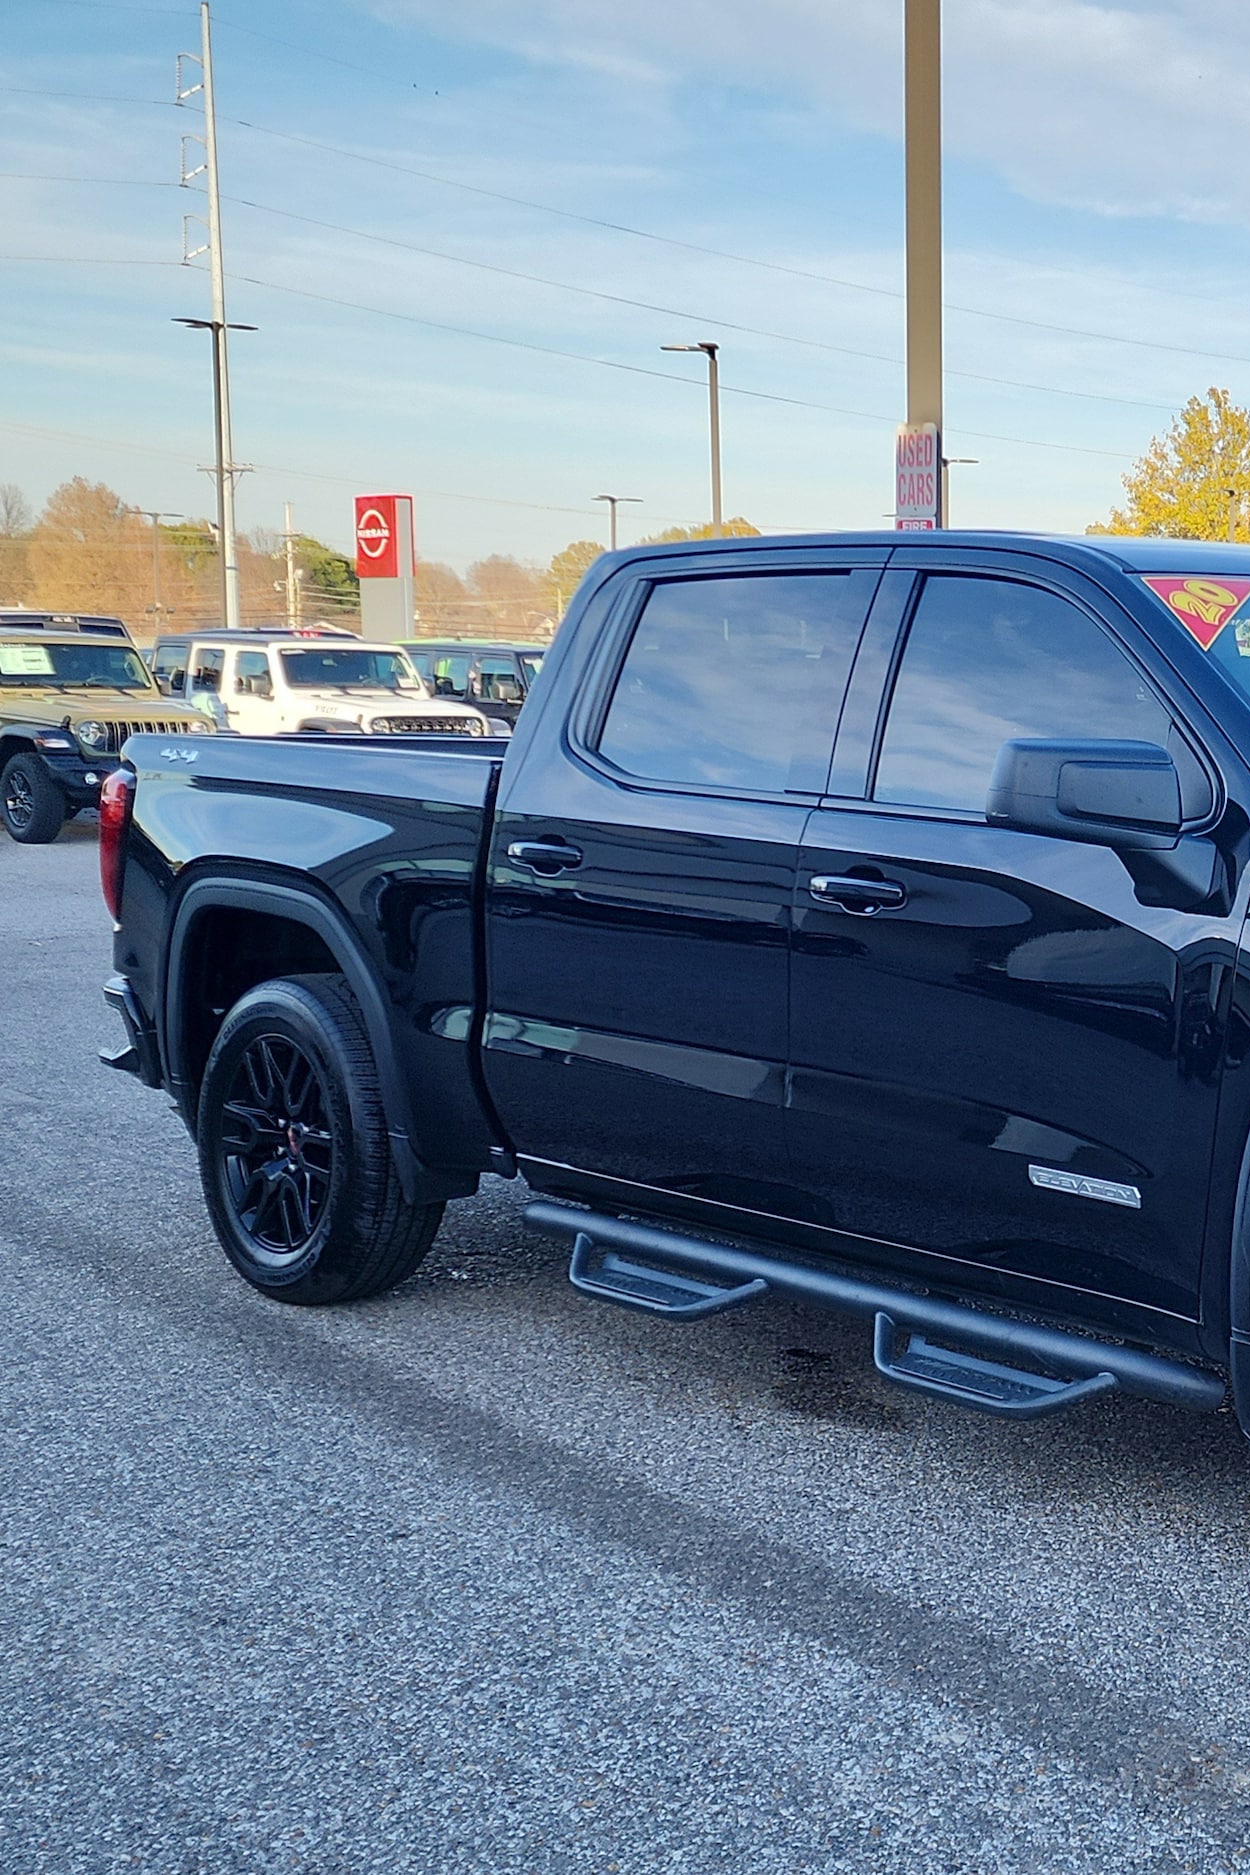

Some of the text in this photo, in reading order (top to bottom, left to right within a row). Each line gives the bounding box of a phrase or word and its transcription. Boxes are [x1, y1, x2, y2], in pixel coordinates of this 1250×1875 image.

[898, 434, 932, 467] USED
[898, 473, 933, 506] CARS
[357, 529, 390, 538] NISSAN
[1169, 579, 1239, 626] 20
[1036, 1171, 1132, 1199] ELEVATION
